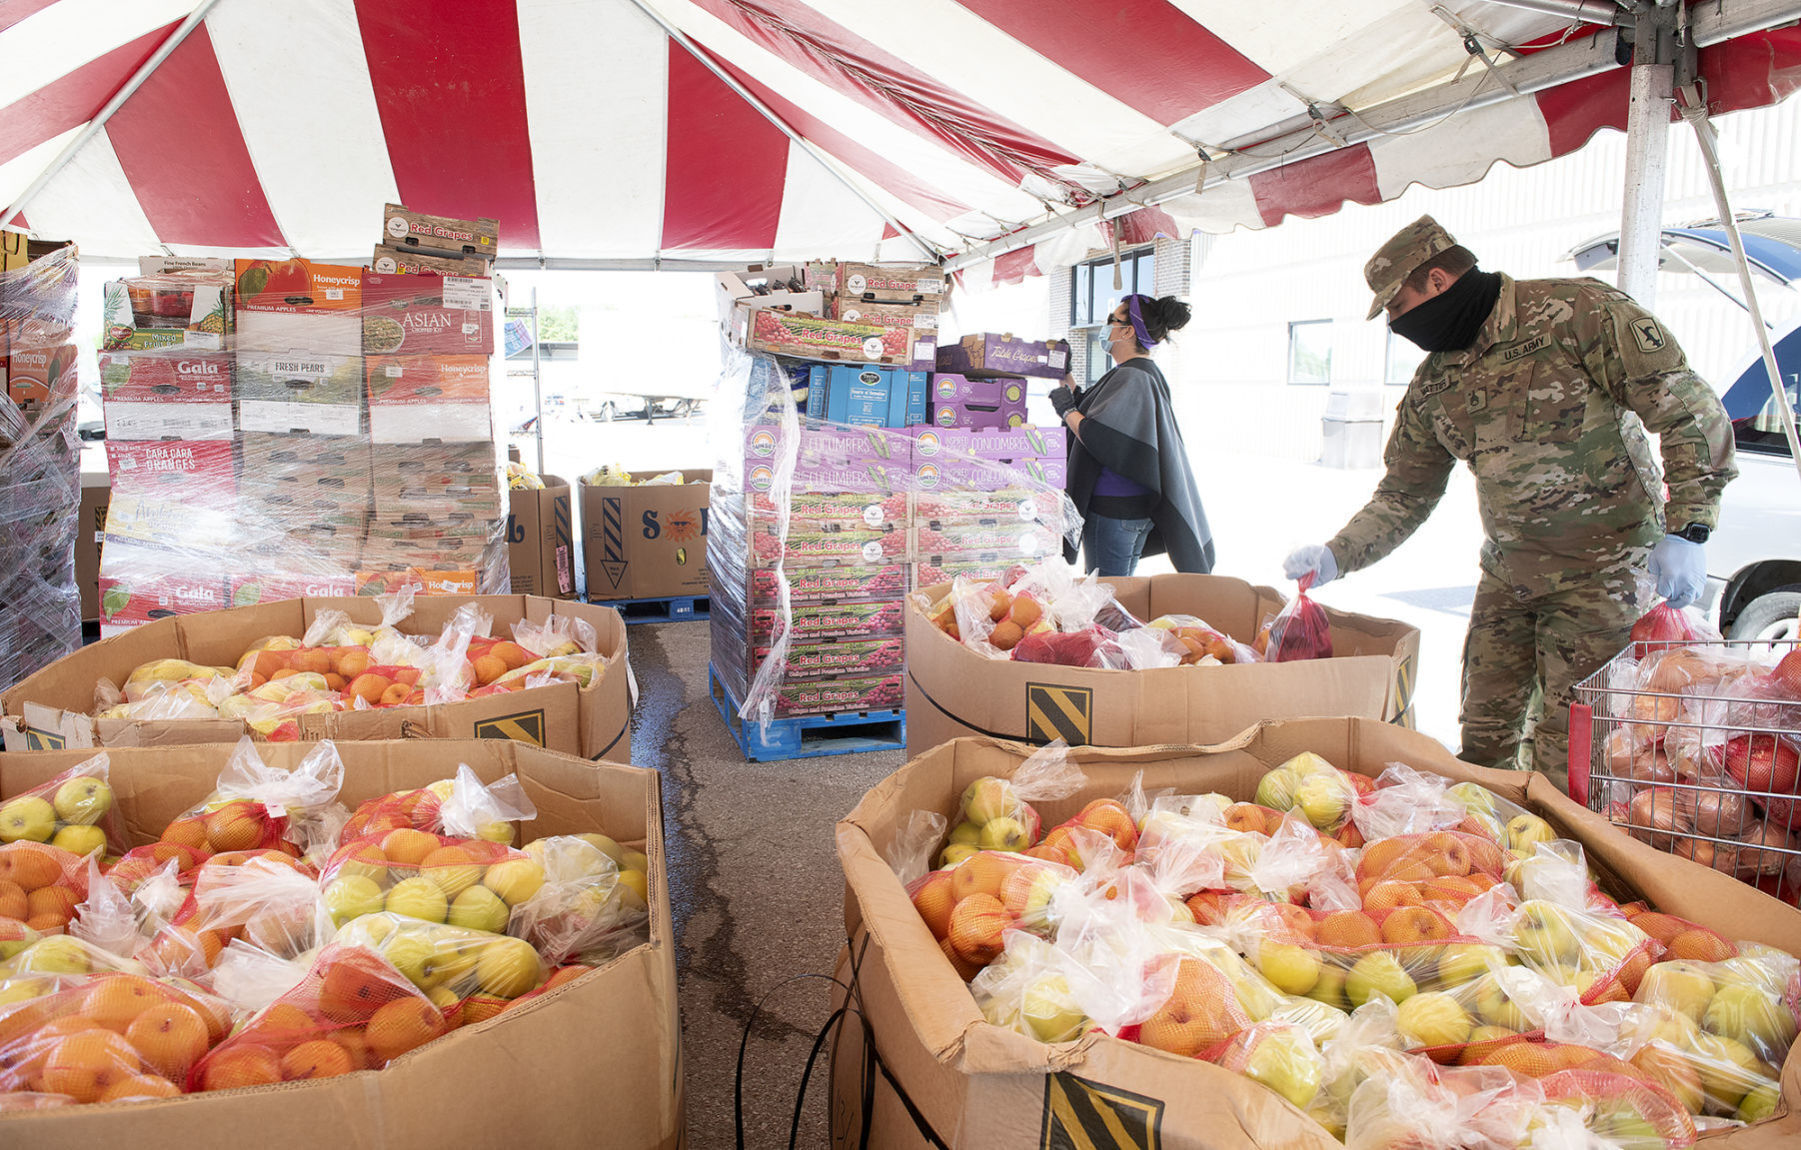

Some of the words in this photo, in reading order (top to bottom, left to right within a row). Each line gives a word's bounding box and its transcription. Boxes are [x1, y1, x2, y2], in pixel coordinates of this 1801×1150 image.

[410, 222, 432, 235] Red
[434, 226, 474, 241] Grapes
[313, 274, 361, 287] Honeycrisp
[867, 278, 886, 289] Red
[402, 312, 452, 327] ASIAN
[801, 328, 824, 341] Red
[825, 332, 863, 345] Grapes
[1504, 348, 1521, 361] U.S.
[1522, 336, 1545, 354] ARMY
[12, 349, 47, 368] Honeycrisp
[177, 360, 218, 375] Gala
[275, 361, 299, 372] FRESH
[301, 363, 325, 373] PEARS
[971, 437, 1030, 451] CONCOMBRES
[146, 448, 169, 459] CARA
[170, 447, 193, 458] CARA
[146, 458, 196, 471] ORANGES
[801, 504, 822, 515] Red
[824, 504, 861, 517] Grapes
[801, 541, 822, 552] Red
[824, 541, 861, 554] Grapes
[800, 579, 820, 589] Red
[822, 577, 860, 589] Grapes
[176, 585, 215, 601] Gala
[305, 584, 344, 597] Gala
[800, 617, 820, 627] Red
[822, 615, 860, 627] Grapes
[800, 655, 820, 665] Red
[822, 653, 860, 665] Grapes
[800, 692, 820, 702] Red
[822, 690, 860, 702] Grapes
